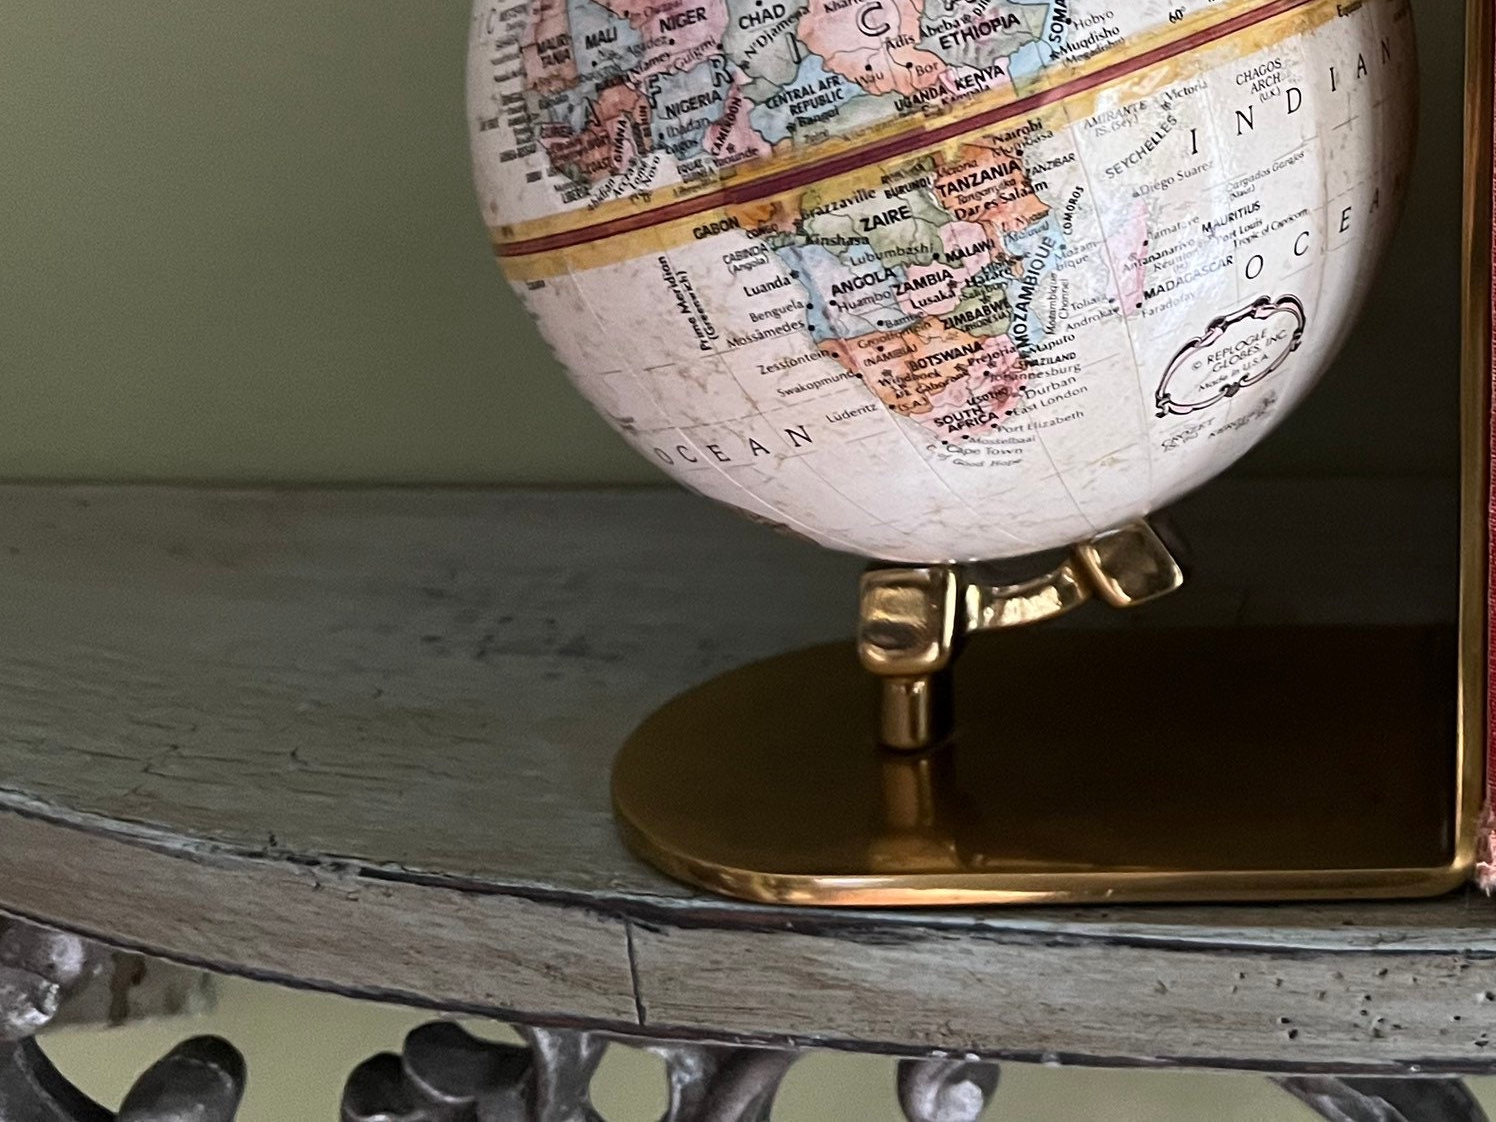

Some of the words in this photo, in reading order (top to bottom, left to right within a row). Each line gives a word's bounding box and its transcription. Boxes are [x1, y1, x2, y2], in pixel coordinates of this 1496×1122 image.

[658, 6, 707, 33] NIGER
[738, 3, 786, 30] CHAD
[585, 26, 618, 50] MALI
[939, 13, 1021, 51] ETHIOPIA
[1059, 24, 1122, 58] Muqdisho
[955, 65, 1006, 92] KENYA
[1235, 57, 1283, 86] CHAGOS
[665, 89, 722, 119] NIGERIA
[789, 88, 845, 117] REPUBLIC
[710, 95, 743, 156] CAMEROON
[613, 118, 628, 164] GHANA
[1105, 114, 1178, 179] SEYCHELLES
[937, 158, 1022, 198] TANZANIA
[860, 205, 912, 233] ZAIRE
[1063, 185, 1086, 237] COMOROS
[1201, 199, 1262, 234] MAURITIUS
[693, 216, 740, 241] GABON
[721, 242, 770, 266] CABINDA
[945, 238, 997, 265] MALAWI
[658, 256, 691, 315] Meridian
[743, 274, 792, 298] Luanda
[830, 266, 897, 297] ANGOLA
[893, 268, 955, 297] ZAMBIA
[1142, 254, 1234, 301] MADAGASCAR
[836, 289, 892, 314] Huambo
[909, 287, 958, 310] Lusaka
[1011, 235, 1058, 355] MOZAMBIQUE
[748, 298, 805, 324] Benguela
[687, 318, 713, 351] Prime
[908, 340, 985, 373] BOTSWANA
[777, 370, 855, 398] Swakopmund
[1024, 374, 1078, 401] Durban
[933, 405, 984, 428] SOUTH
[948, 410, 1000, 435] AFRICA
[653, 424, 813, 466] OCEAN
